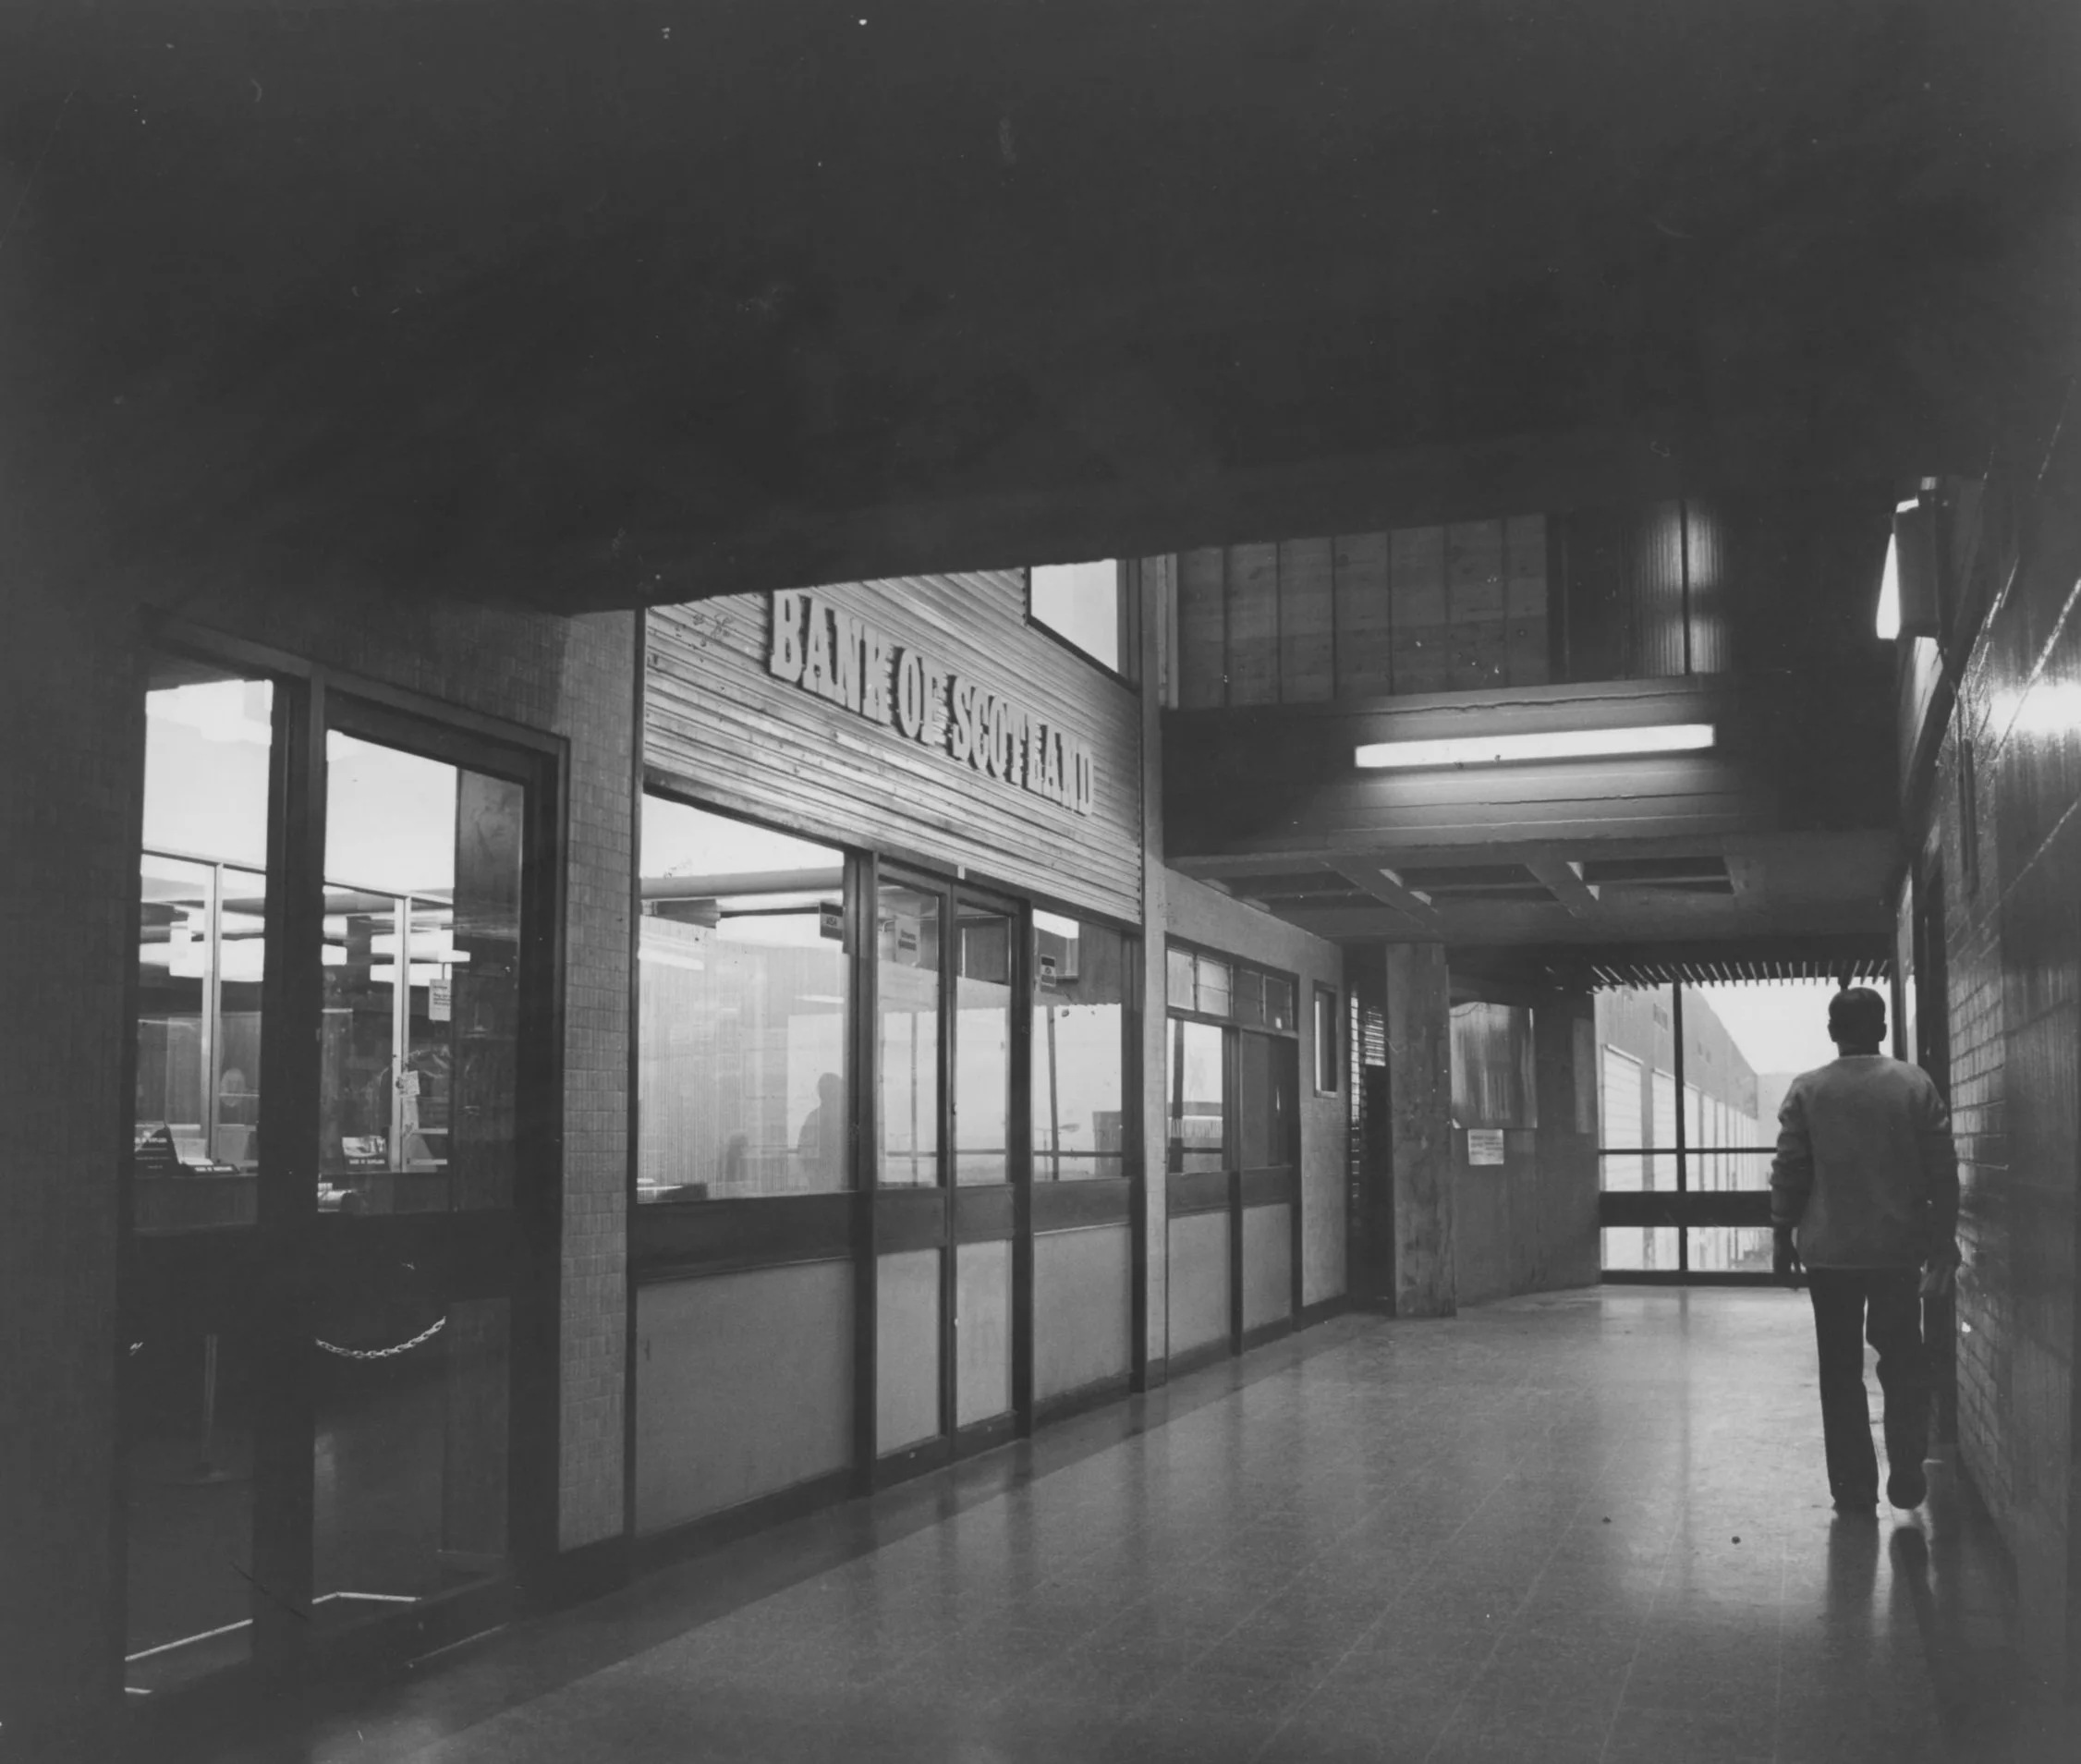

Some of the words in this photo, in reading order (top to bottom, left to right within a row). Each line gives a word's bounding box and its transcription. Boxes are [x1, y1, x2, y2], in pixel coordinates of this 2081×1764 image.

[770, 589, 894, 726] BANK
[898, 647, 949, 747] OF
[952, 674, 1095, 817] SCOTLAND
